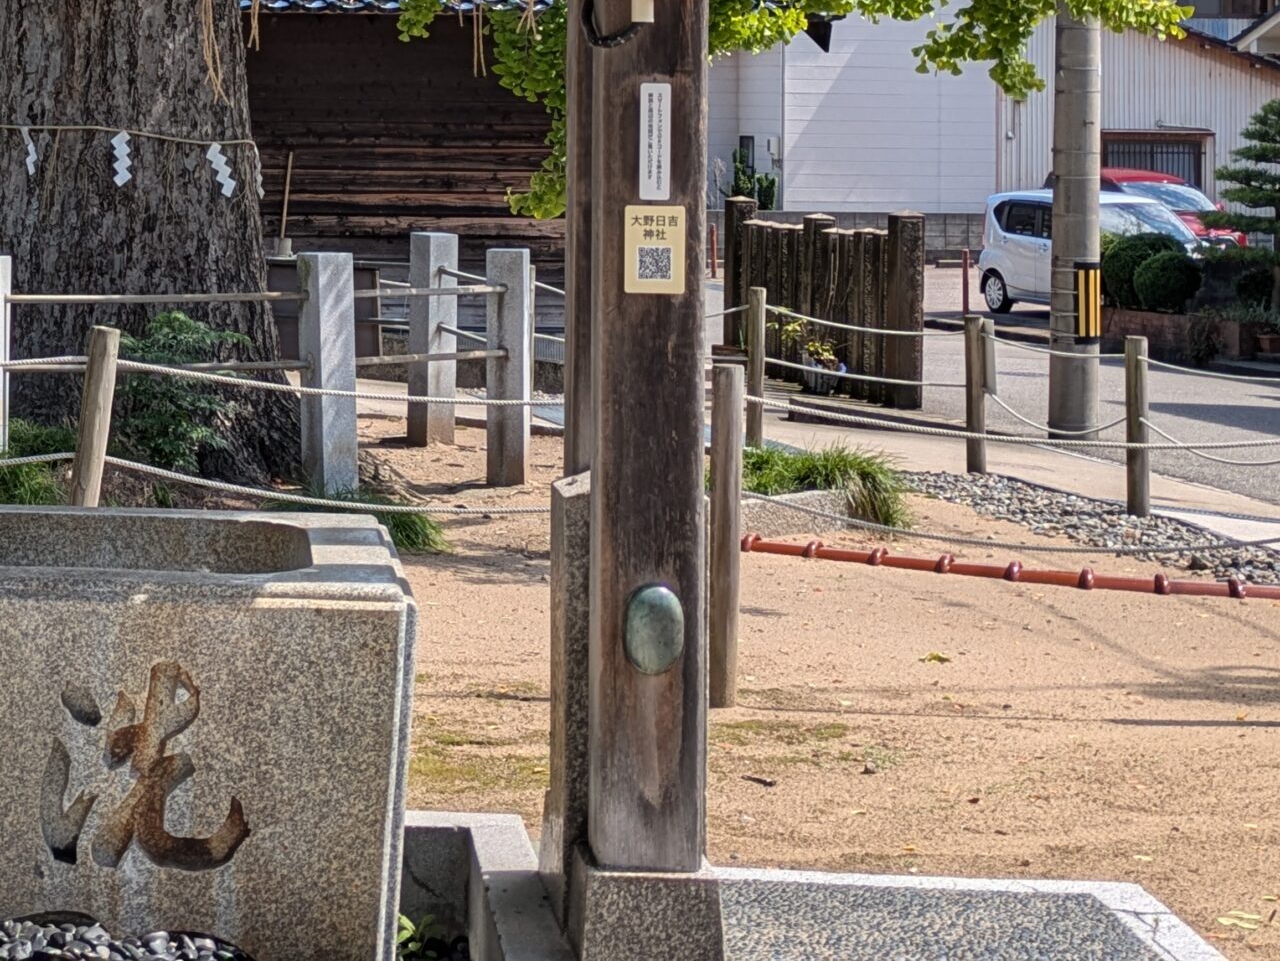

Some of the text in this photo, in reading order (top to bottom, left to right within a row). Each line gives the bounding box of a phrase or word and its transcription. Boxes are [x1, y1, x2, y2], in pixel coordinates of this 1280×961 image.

[631, 214, 678, 227] 大野日吉
[642, 228, 667, 241] 神社
